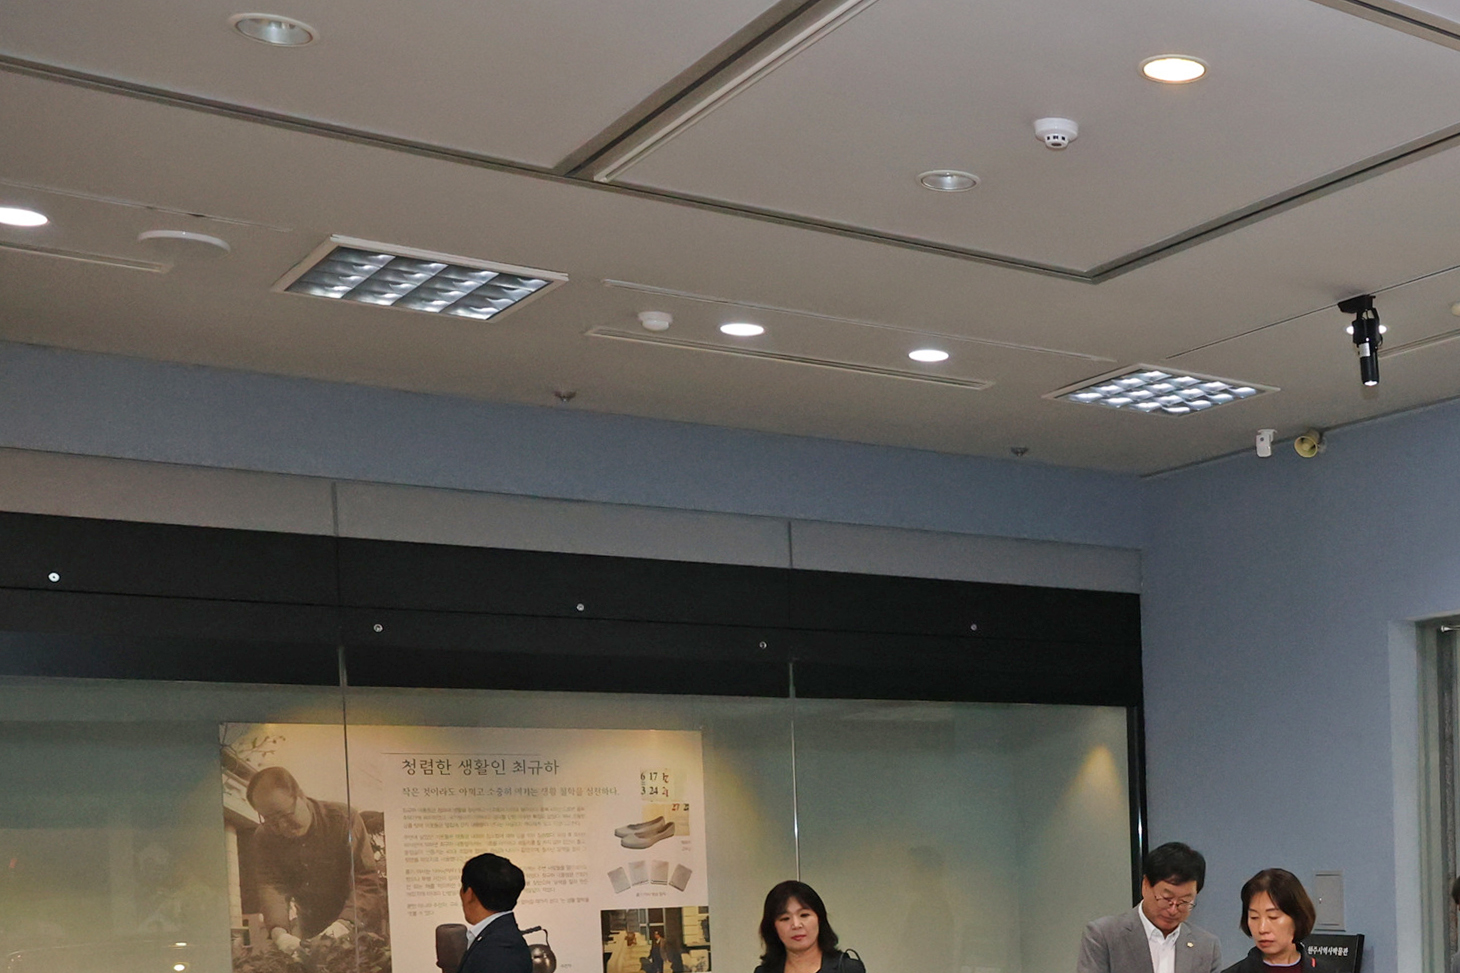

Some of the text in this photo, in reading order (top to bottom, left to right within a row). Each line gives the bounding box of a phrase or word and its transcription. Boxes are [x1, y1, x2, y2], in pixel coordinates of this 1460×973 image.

[402, 758, 559, 776] 청렴한 생활인 최규하
[649, 772, 658, 781] 17
[402, 786, 420, 797] 작은
[424, 786, 456, 797] 것이라도
[487, 786, 512, 797] 소중히
[649, 786, 658, 795] 24
[1307, 945, 1349, 956] 원주시역사박물관
